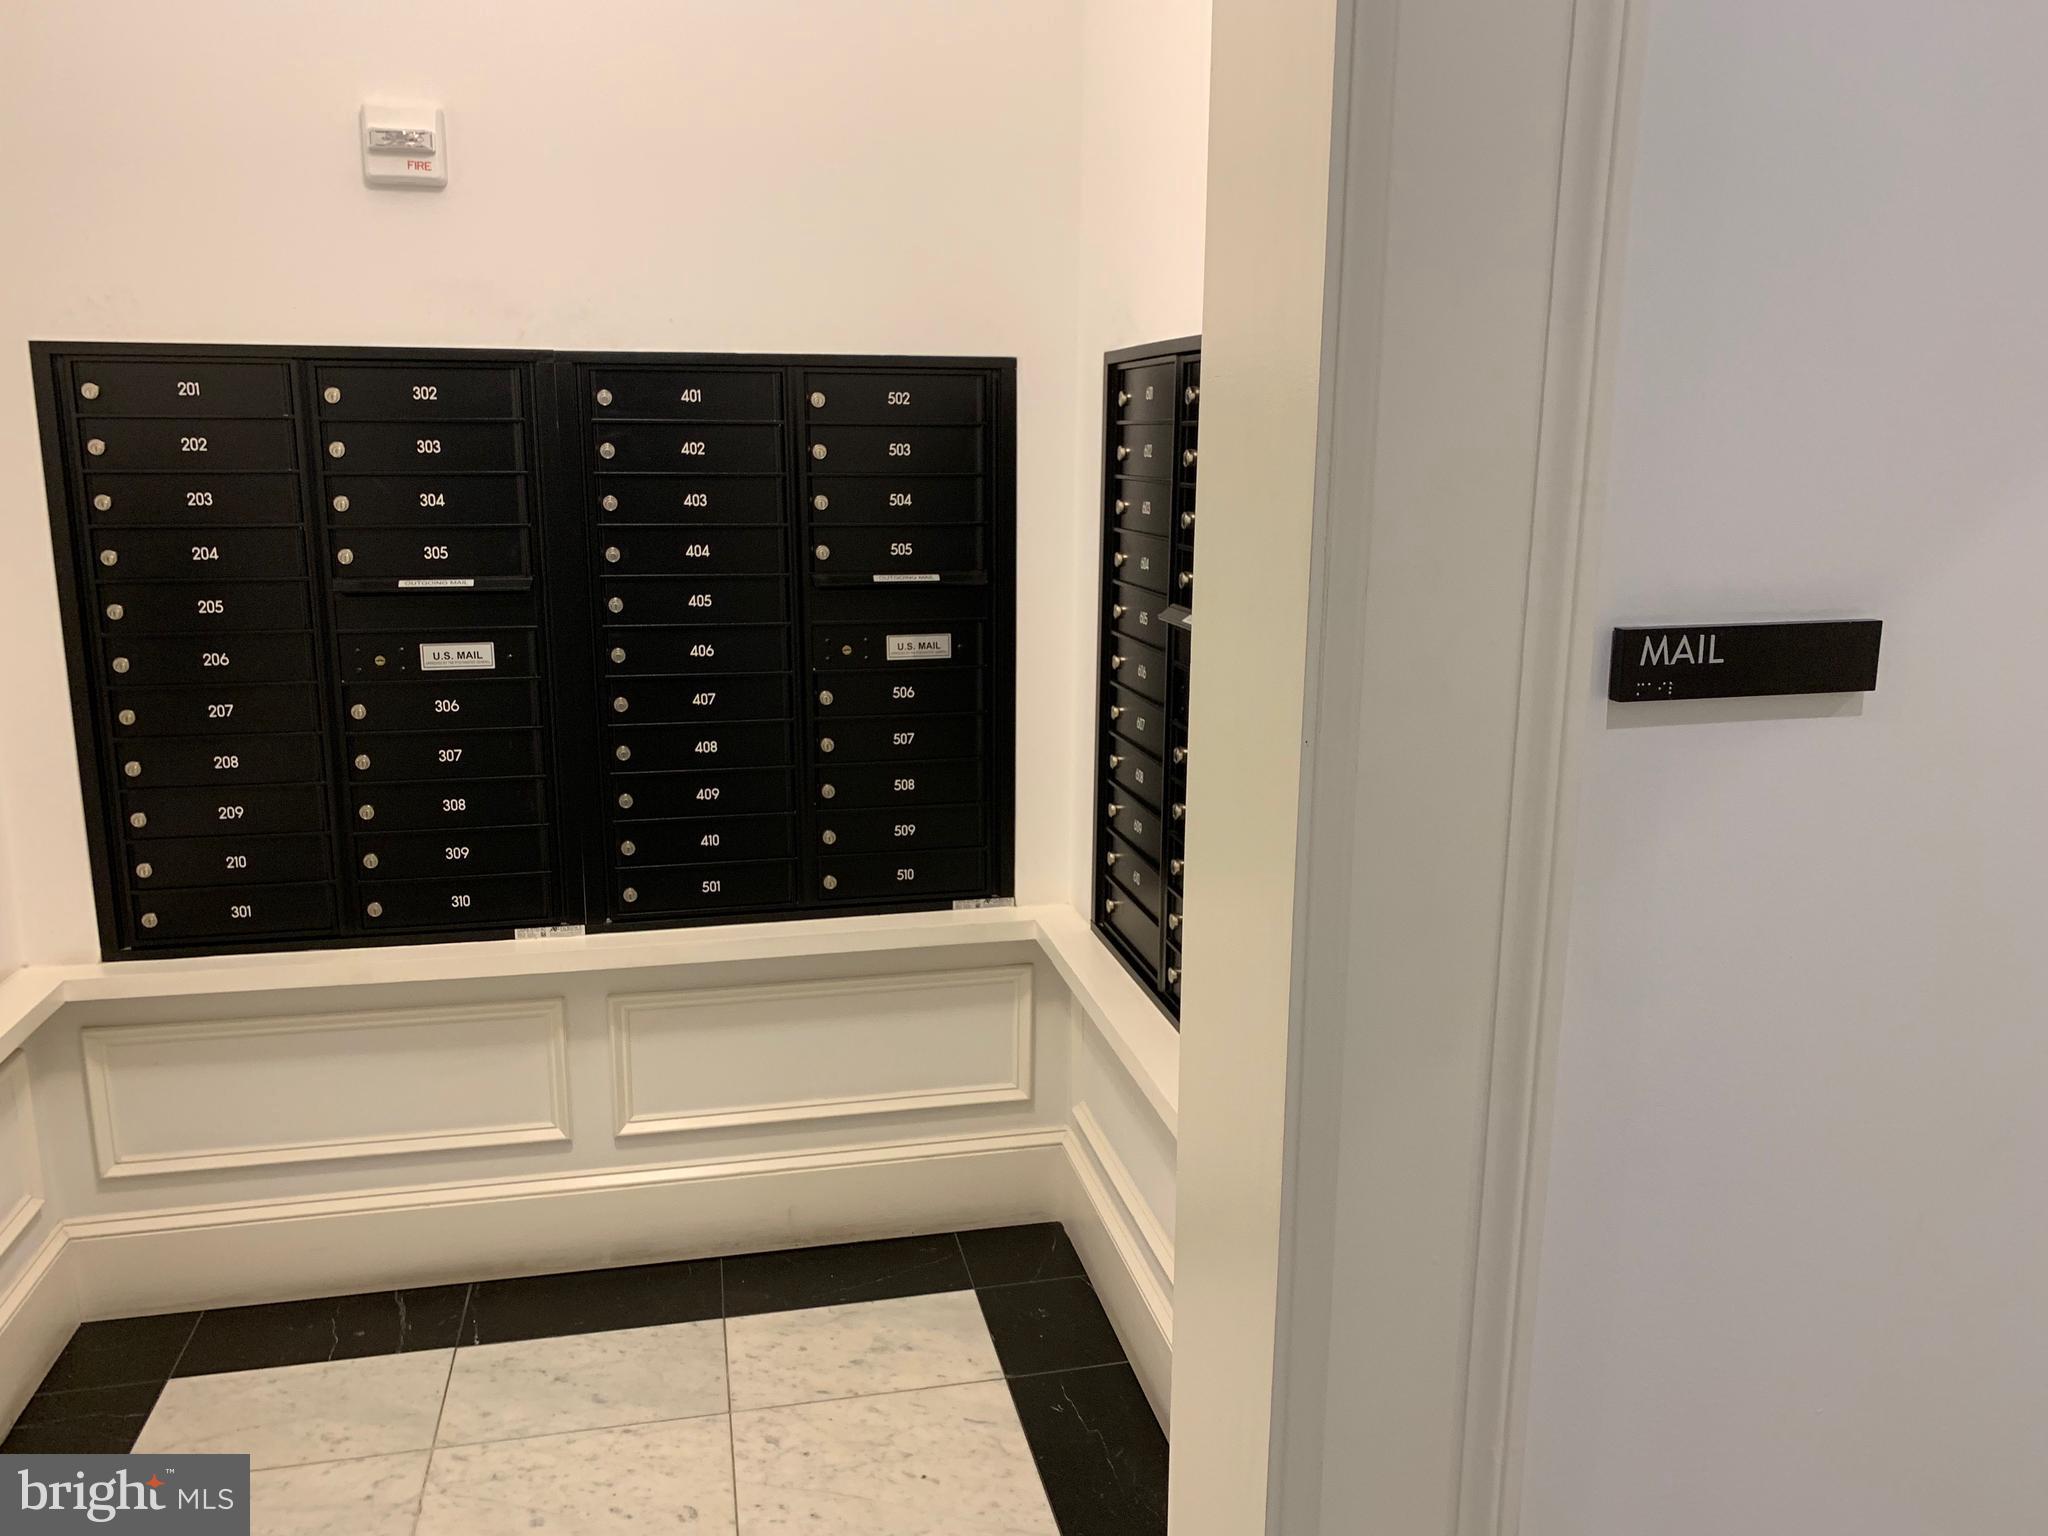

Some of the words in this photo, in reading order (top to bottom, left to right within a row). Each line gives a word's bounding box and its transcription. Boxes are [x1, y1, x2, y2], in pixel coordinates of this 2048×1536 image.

[407, 160, 432, 171] FIRE
[177, 381, 200, 397] 201
[412, 385, 438, 401] 302
[680, 388, 702, 403] 401
[887, 391, 911, 405] 502
[180, 437, 208, 452] 202
[416, 439, 441, 454] 303
[680, 441, 706, 456] 402
[888, 443, 911, 457] 503
[186, 491, 213, 506] 203
[419, 493, 446, 507] 304
[683, 493, 708, 507] 403
[889, 493, 913, 507] 504
[191, 546, 220, 561] 204
[423, 545, 449, 560] 305
[685, 544, 711, 558] 404
[890, 542, 913, 556] 505
[197, 599, 224, 614] 205
[688, 594, 713, 608] 405
[1139, 611, 1148, 626] 605
[689, 644, 715, 657] 406
[897, 642, 915, 651] U.S.
[918, 641, 941, 650] MAIL
[1640, 634, 1724, 666] MAIL
[202, 652, 230, 667] 206
[433, 651, 454, 661] U.S.
[457, 650, 483, 660] MAIL
[692, 692, 716, 706] 407
[892, 686, 916, 699] 506
[208, 703, 234, 718] 207
[434, 699, 460, 713] 306
[1136, 716, 1146, 731] 607
[892, 732, 915, 745] 507
[694, 740, 718, 754] 408
[213, 755, 239, 770] 208
[438, 748, 463, 763] 307
[893, 778, 915, 791] 508
[695, 787, 720, 801] 409
[442, 798, 467, 812] 308
[217, 805, 244, 820] 209
[894, 824, 916, 837] 509
[1133, 818, 1143, 834] 609
[700, 833, 720, 847] 410
[445, 846, 470, 860] 309
[225, 855, 247, 869] 210
[896, 868, 915, 881] 510
[701, 880, 721, 894] 501
[451, 894, 471, 908] 310
[230, 904, 252, 919] 301
